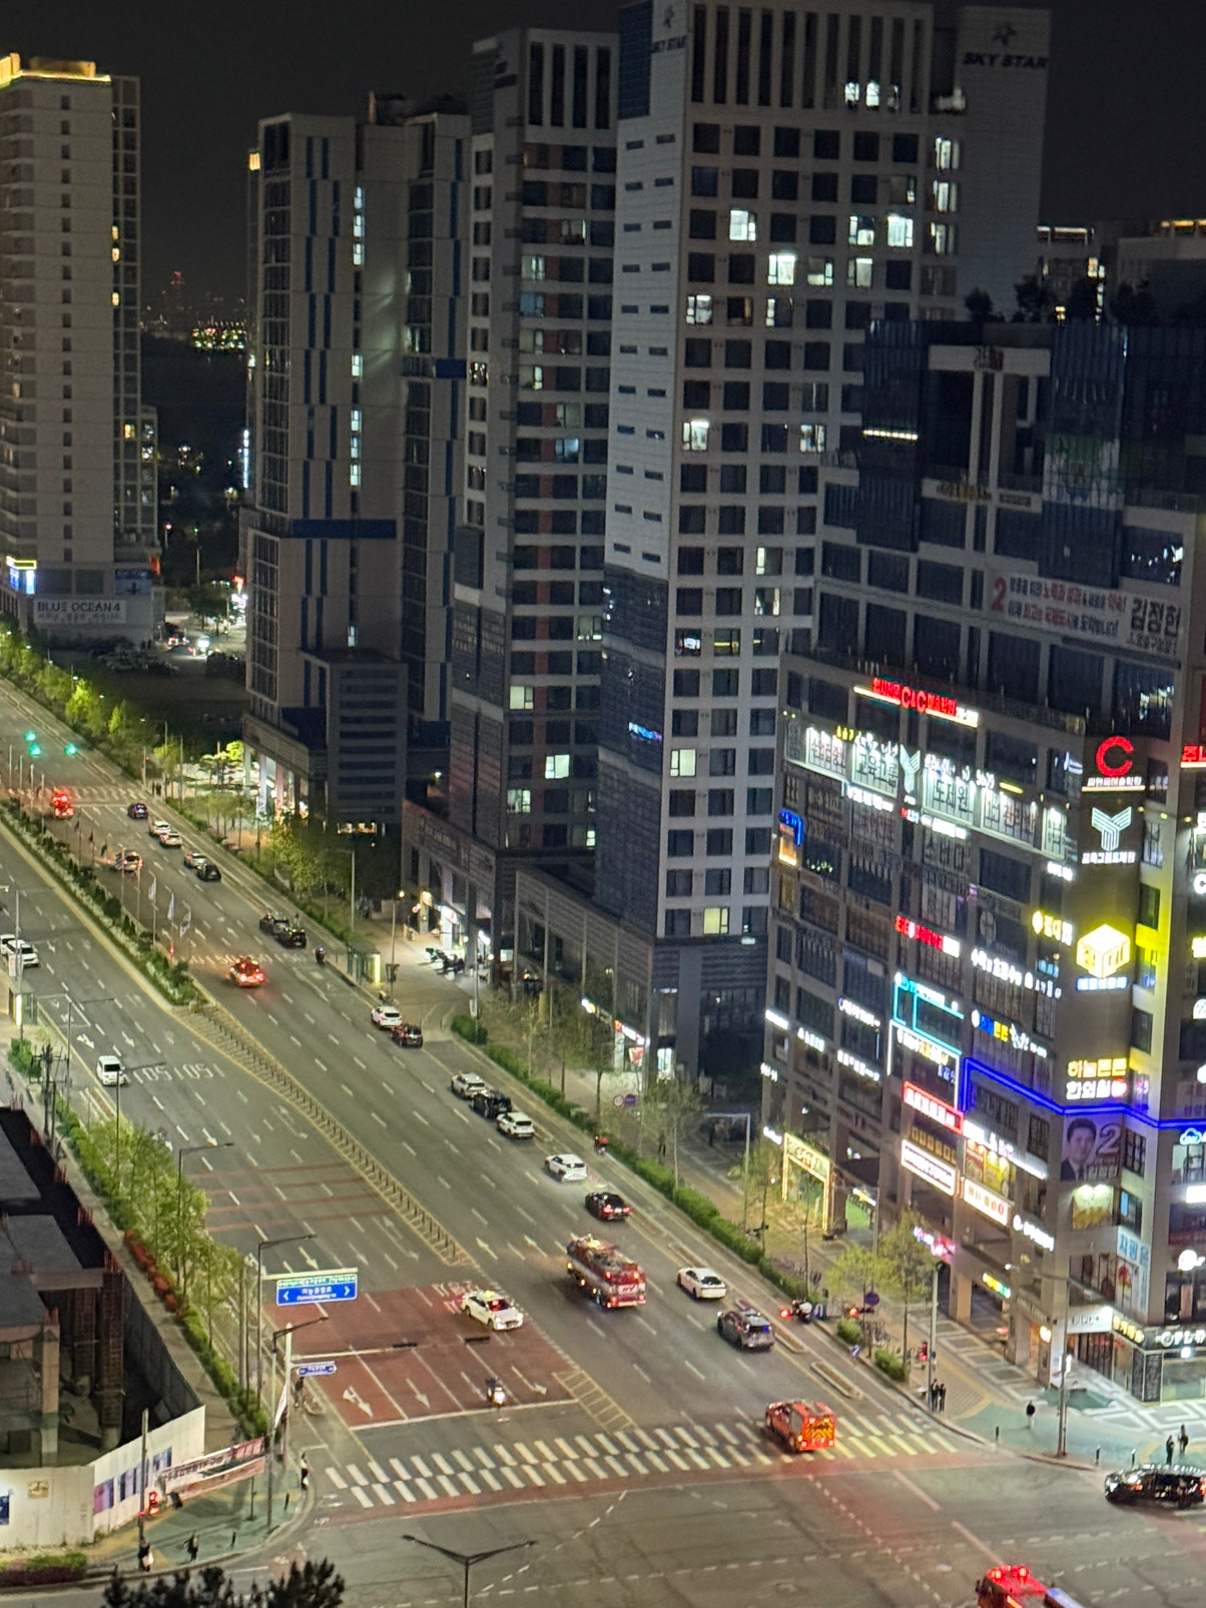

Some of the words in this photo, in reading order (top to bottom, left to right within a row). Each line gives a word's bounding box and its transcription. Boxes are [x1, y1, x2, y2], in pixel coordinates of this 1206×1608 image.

[964, 52, 999, 66] SKY
[1001, 55, 1049, 69] STAR
[38, 601, 67, 612] BLUE
[992, 577, 1007, 612] 2
[1095, 735, 1135, 777] C
[1067, 1057, 1127, 1079] 하늘튼튼
[1096, 1122, 1122, 1154] 2
